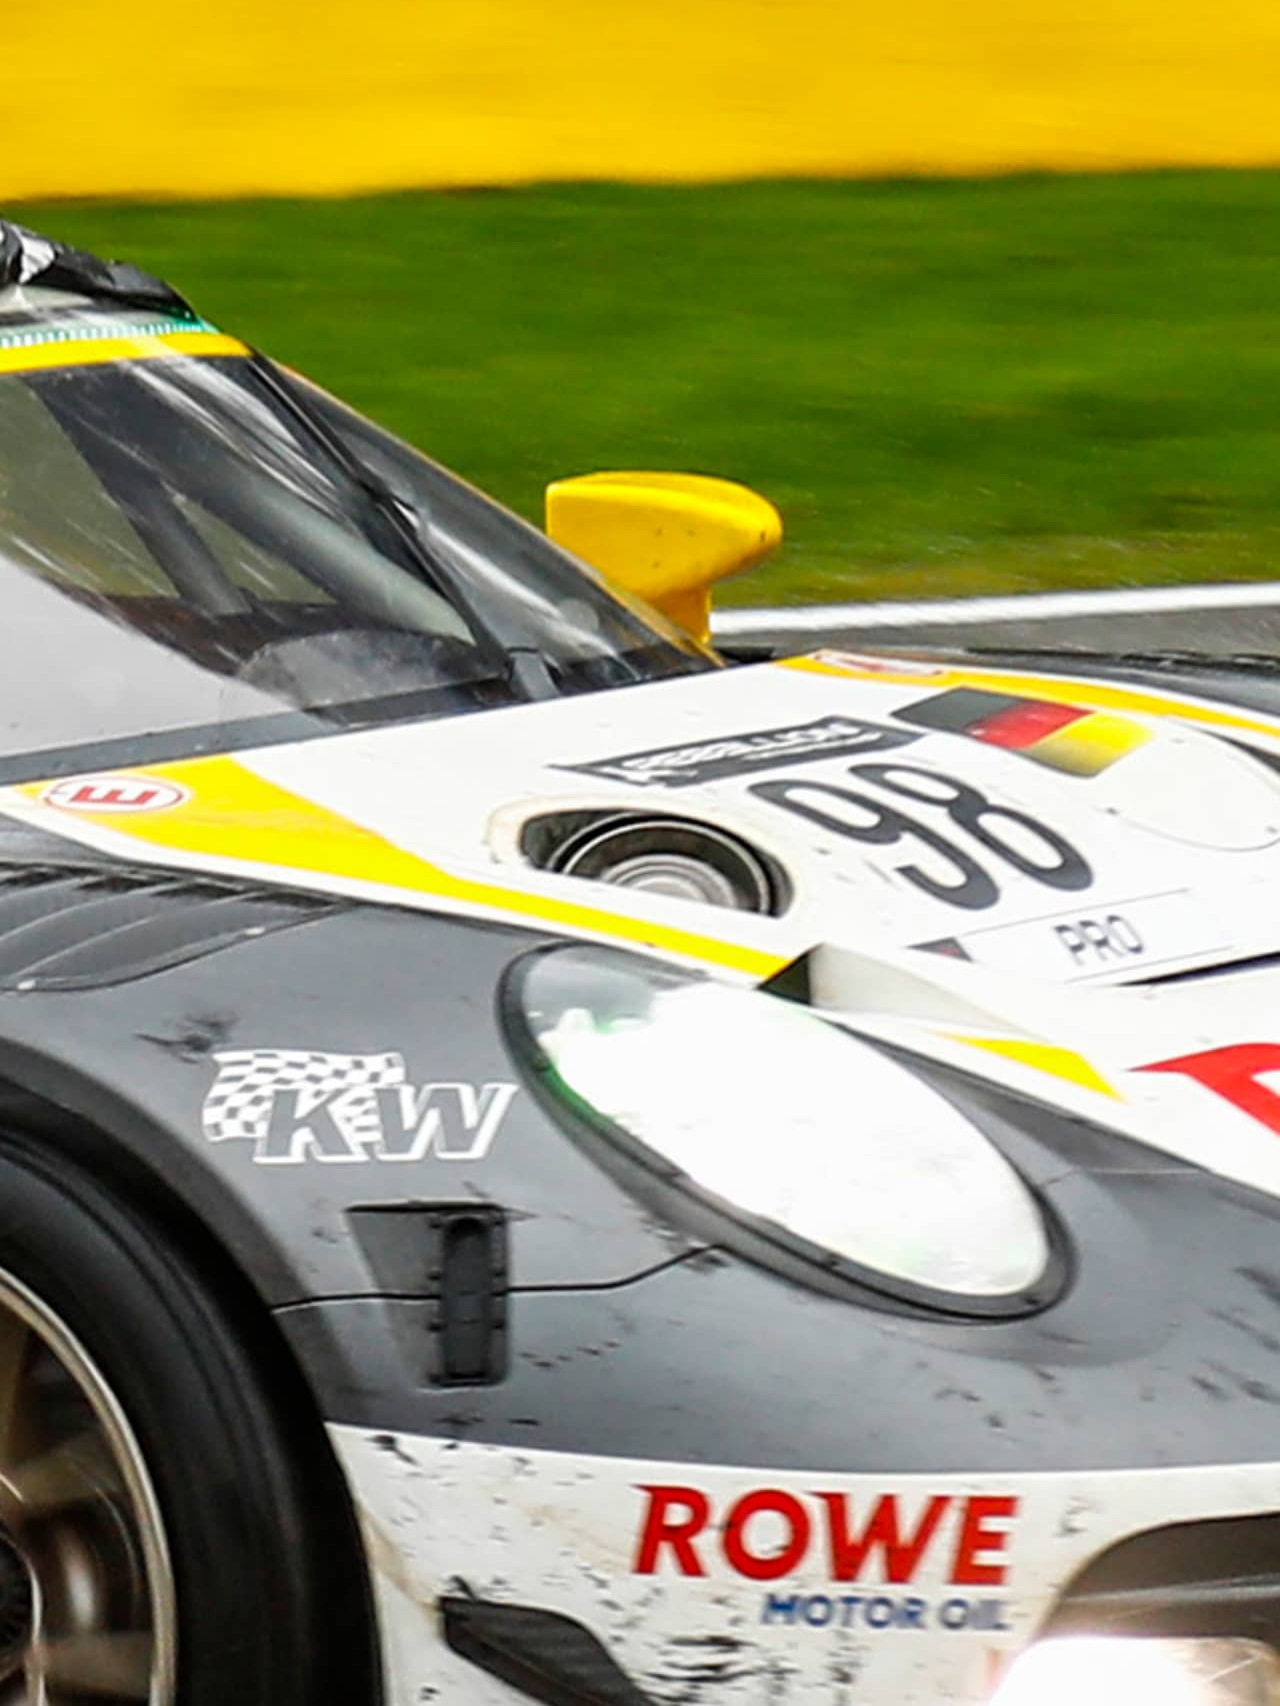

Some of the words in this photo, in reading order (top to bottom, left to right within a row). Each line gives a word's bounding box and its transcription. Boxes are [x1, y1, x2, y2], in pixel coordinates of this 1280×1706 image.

[747, 763, 1094, 911] 98
[1053, 914, 1145, 966] PRO
[252, 1083, 519, 1164] KW
[630, 1484, 1022, 1586] ROWE
[761, 1593, 927, 1629] MOTOR
[939, 1597, 1012, 1631] OIL
